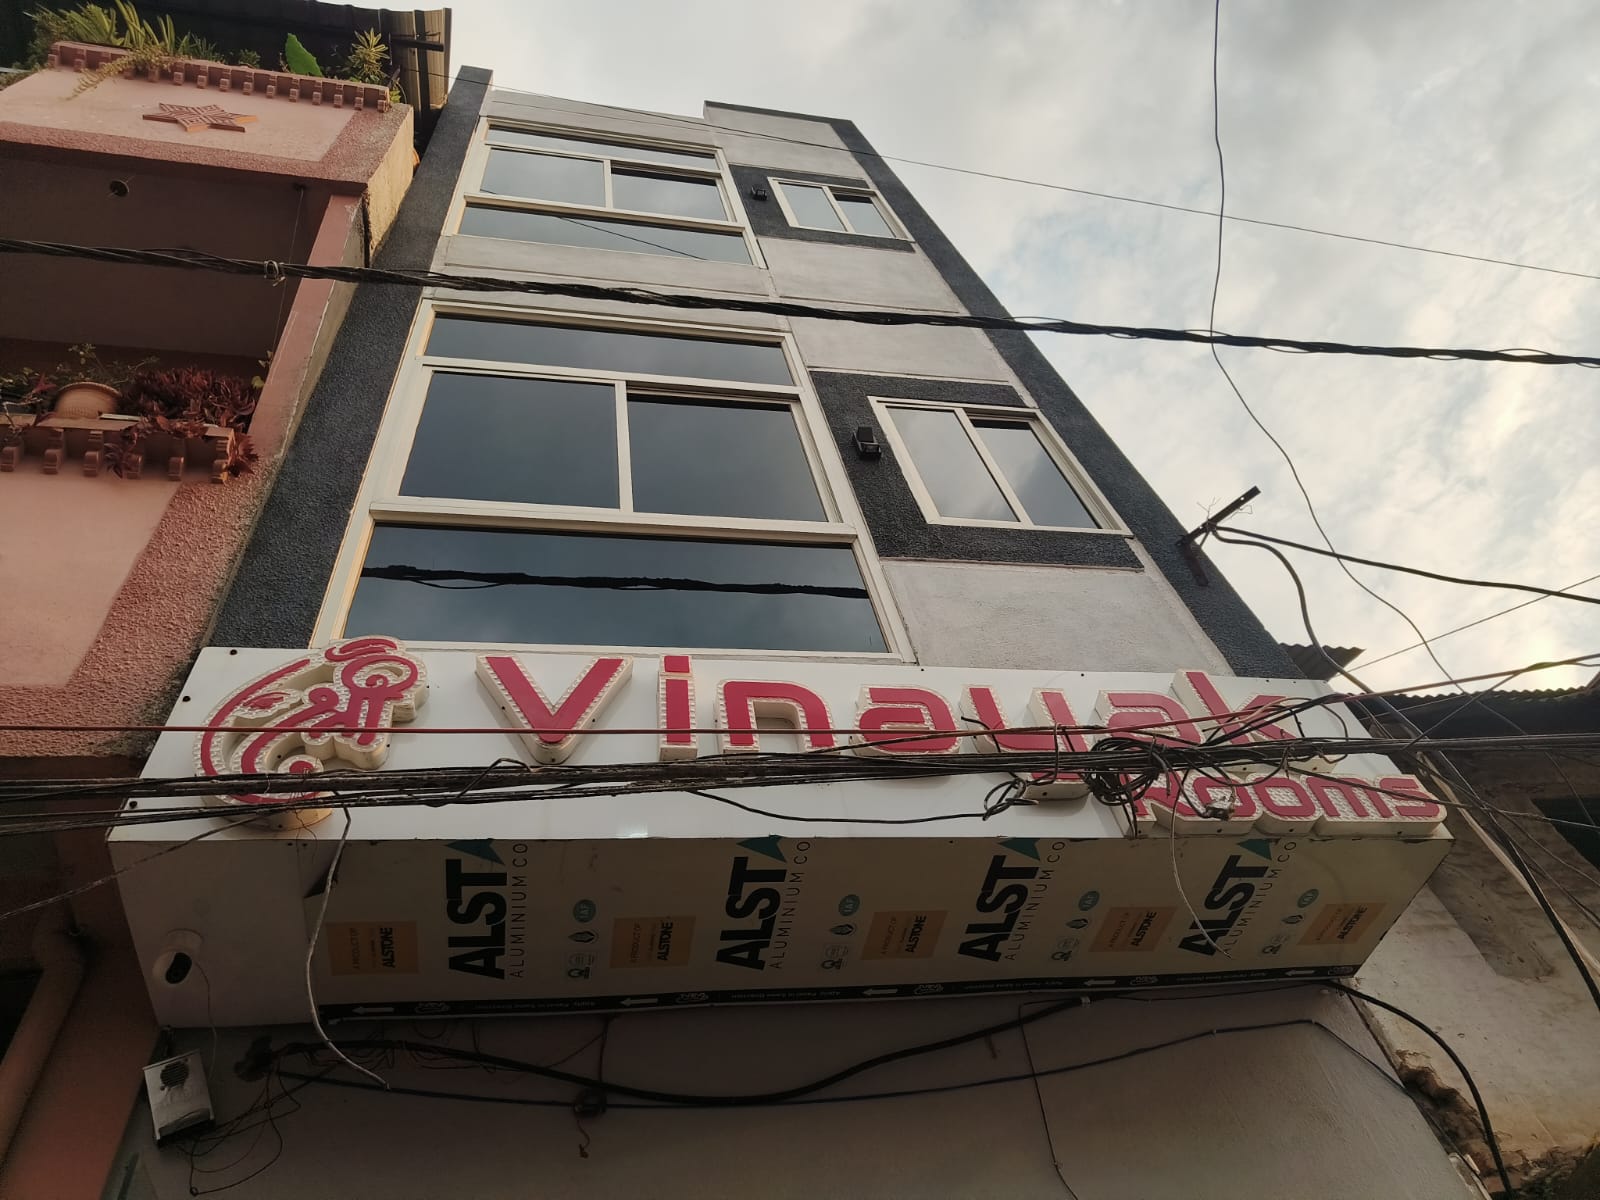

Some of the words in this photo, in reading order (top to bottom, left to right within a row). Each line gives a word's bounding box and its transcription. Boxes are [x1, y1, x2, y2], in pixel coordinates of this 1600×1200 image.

[480, 655, 1310, 782] Vinayak
[510, 875, 528, 978] ALUMINIUM
[768, 872, 806, 969] ALUMINIUM
[1005, 869, 1055, 961] ALUMINIUM
